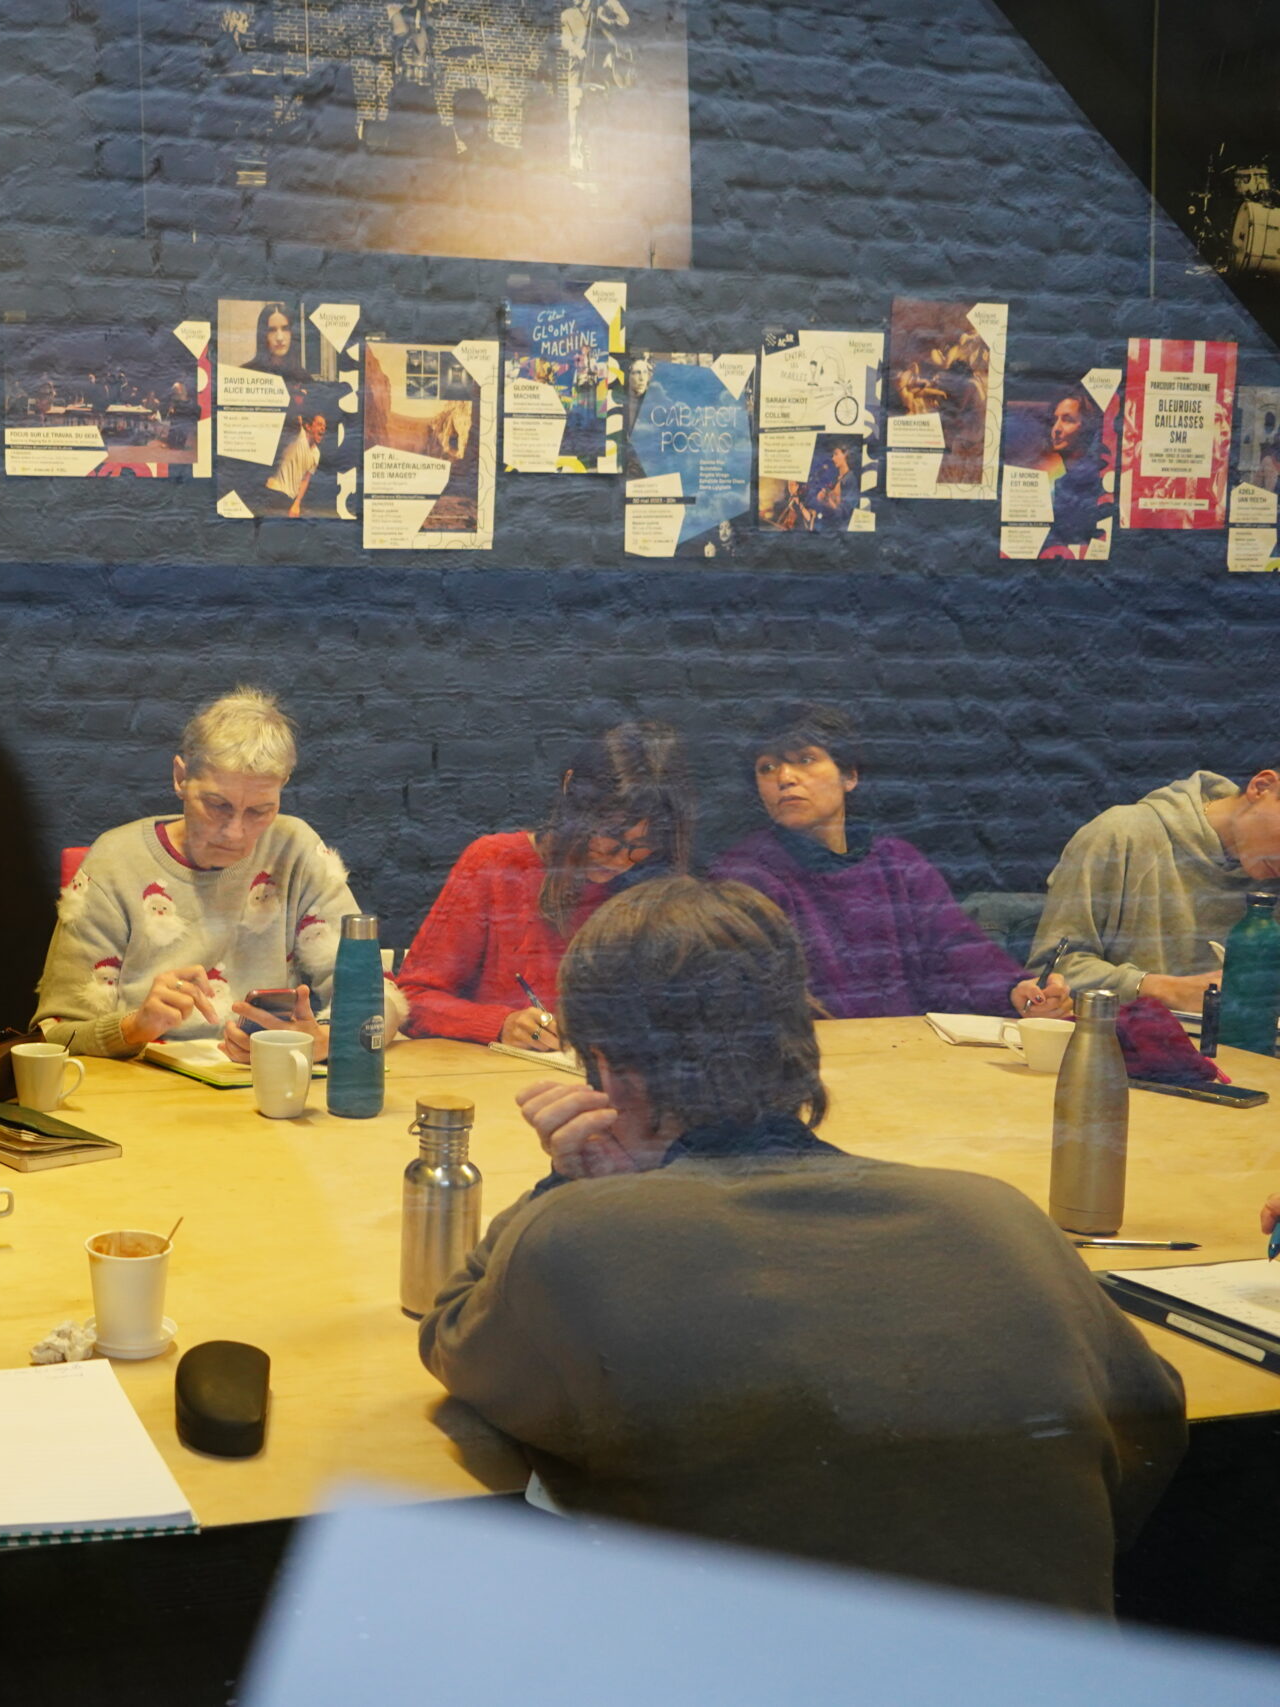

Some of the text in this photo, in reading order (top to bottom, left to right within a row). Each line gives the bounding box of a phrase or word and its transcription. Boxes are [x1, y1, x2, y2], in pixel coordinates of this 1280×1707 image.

[320, 312, 347, 321] Maison
[461, 346, 487, 355] Maison
[224, 377, 274, 386] DAVID LAFORE
[1151, 381, 1175, 390] PARCOURS
[223, 386, 285, 395] ALICE BUTTERLIN
[1158, 399, 1202, 413] BLEUROISE
[650, 405, 742, 428] CABARET
[1154, 415, 1204, 429] CAILLASSES
[1169, 431, 1188, 444] SMR
